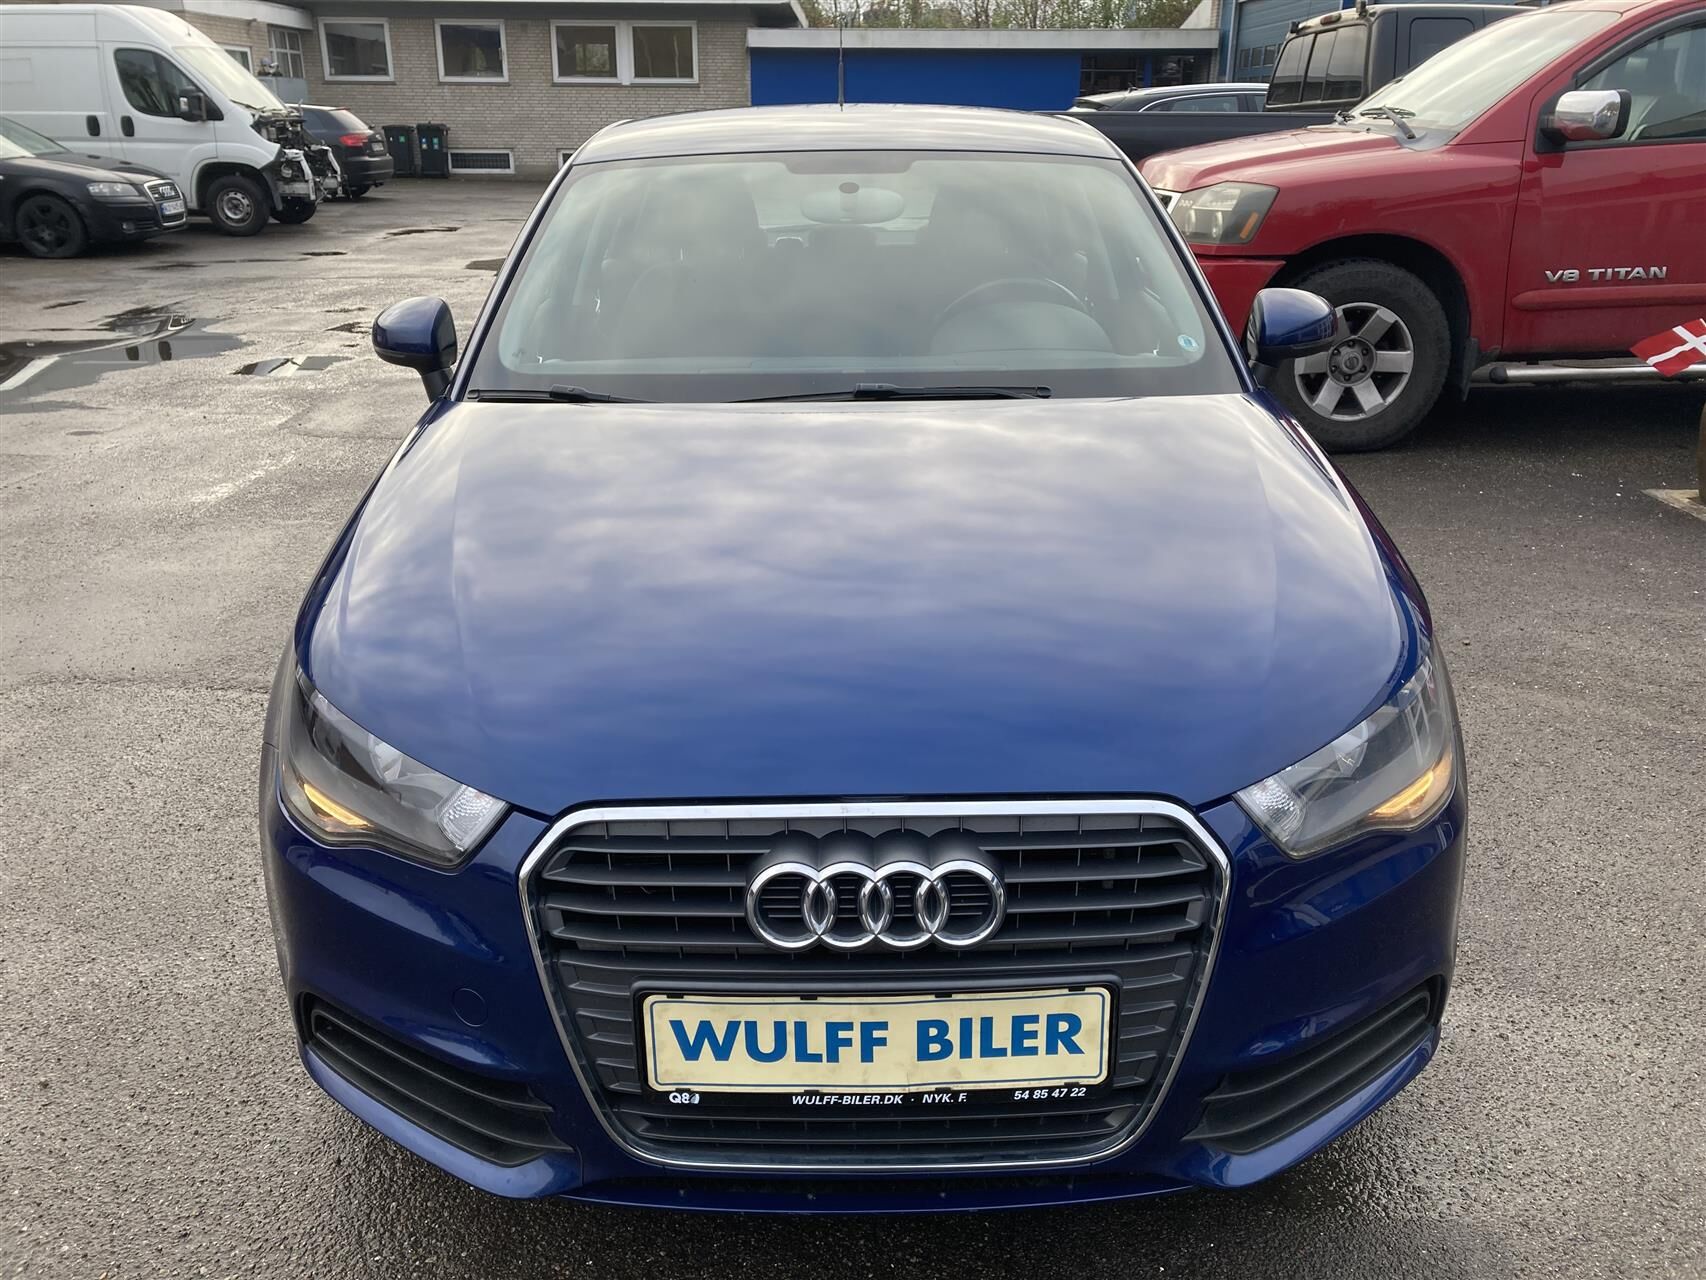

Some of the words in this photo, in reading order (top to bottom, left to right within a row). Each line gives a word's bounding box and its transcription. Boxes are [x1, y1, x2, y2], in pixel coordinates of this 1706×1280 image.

[1545, 269, 1580, 282] V8
[1588, 266, 1667, 280] TITAN
[668, 1019, 889, 1064] WULFF
[916, 1012, 1086, 1062] BILER
[669, 1092, 690, 1104] Q8
[792, 1094, 904, 1105] WULFF-BILER.DK
[922, 1093, 954, 1103] NYK.
[958, 1092, 968, 1102] F.
[1014, 1090, 1030, 1100] 54
[1033, 1089, 1049, 1099] 85
[1051, 1088, 1068, 1098] 47
[1070, 1087, 1087, 1097] 22
